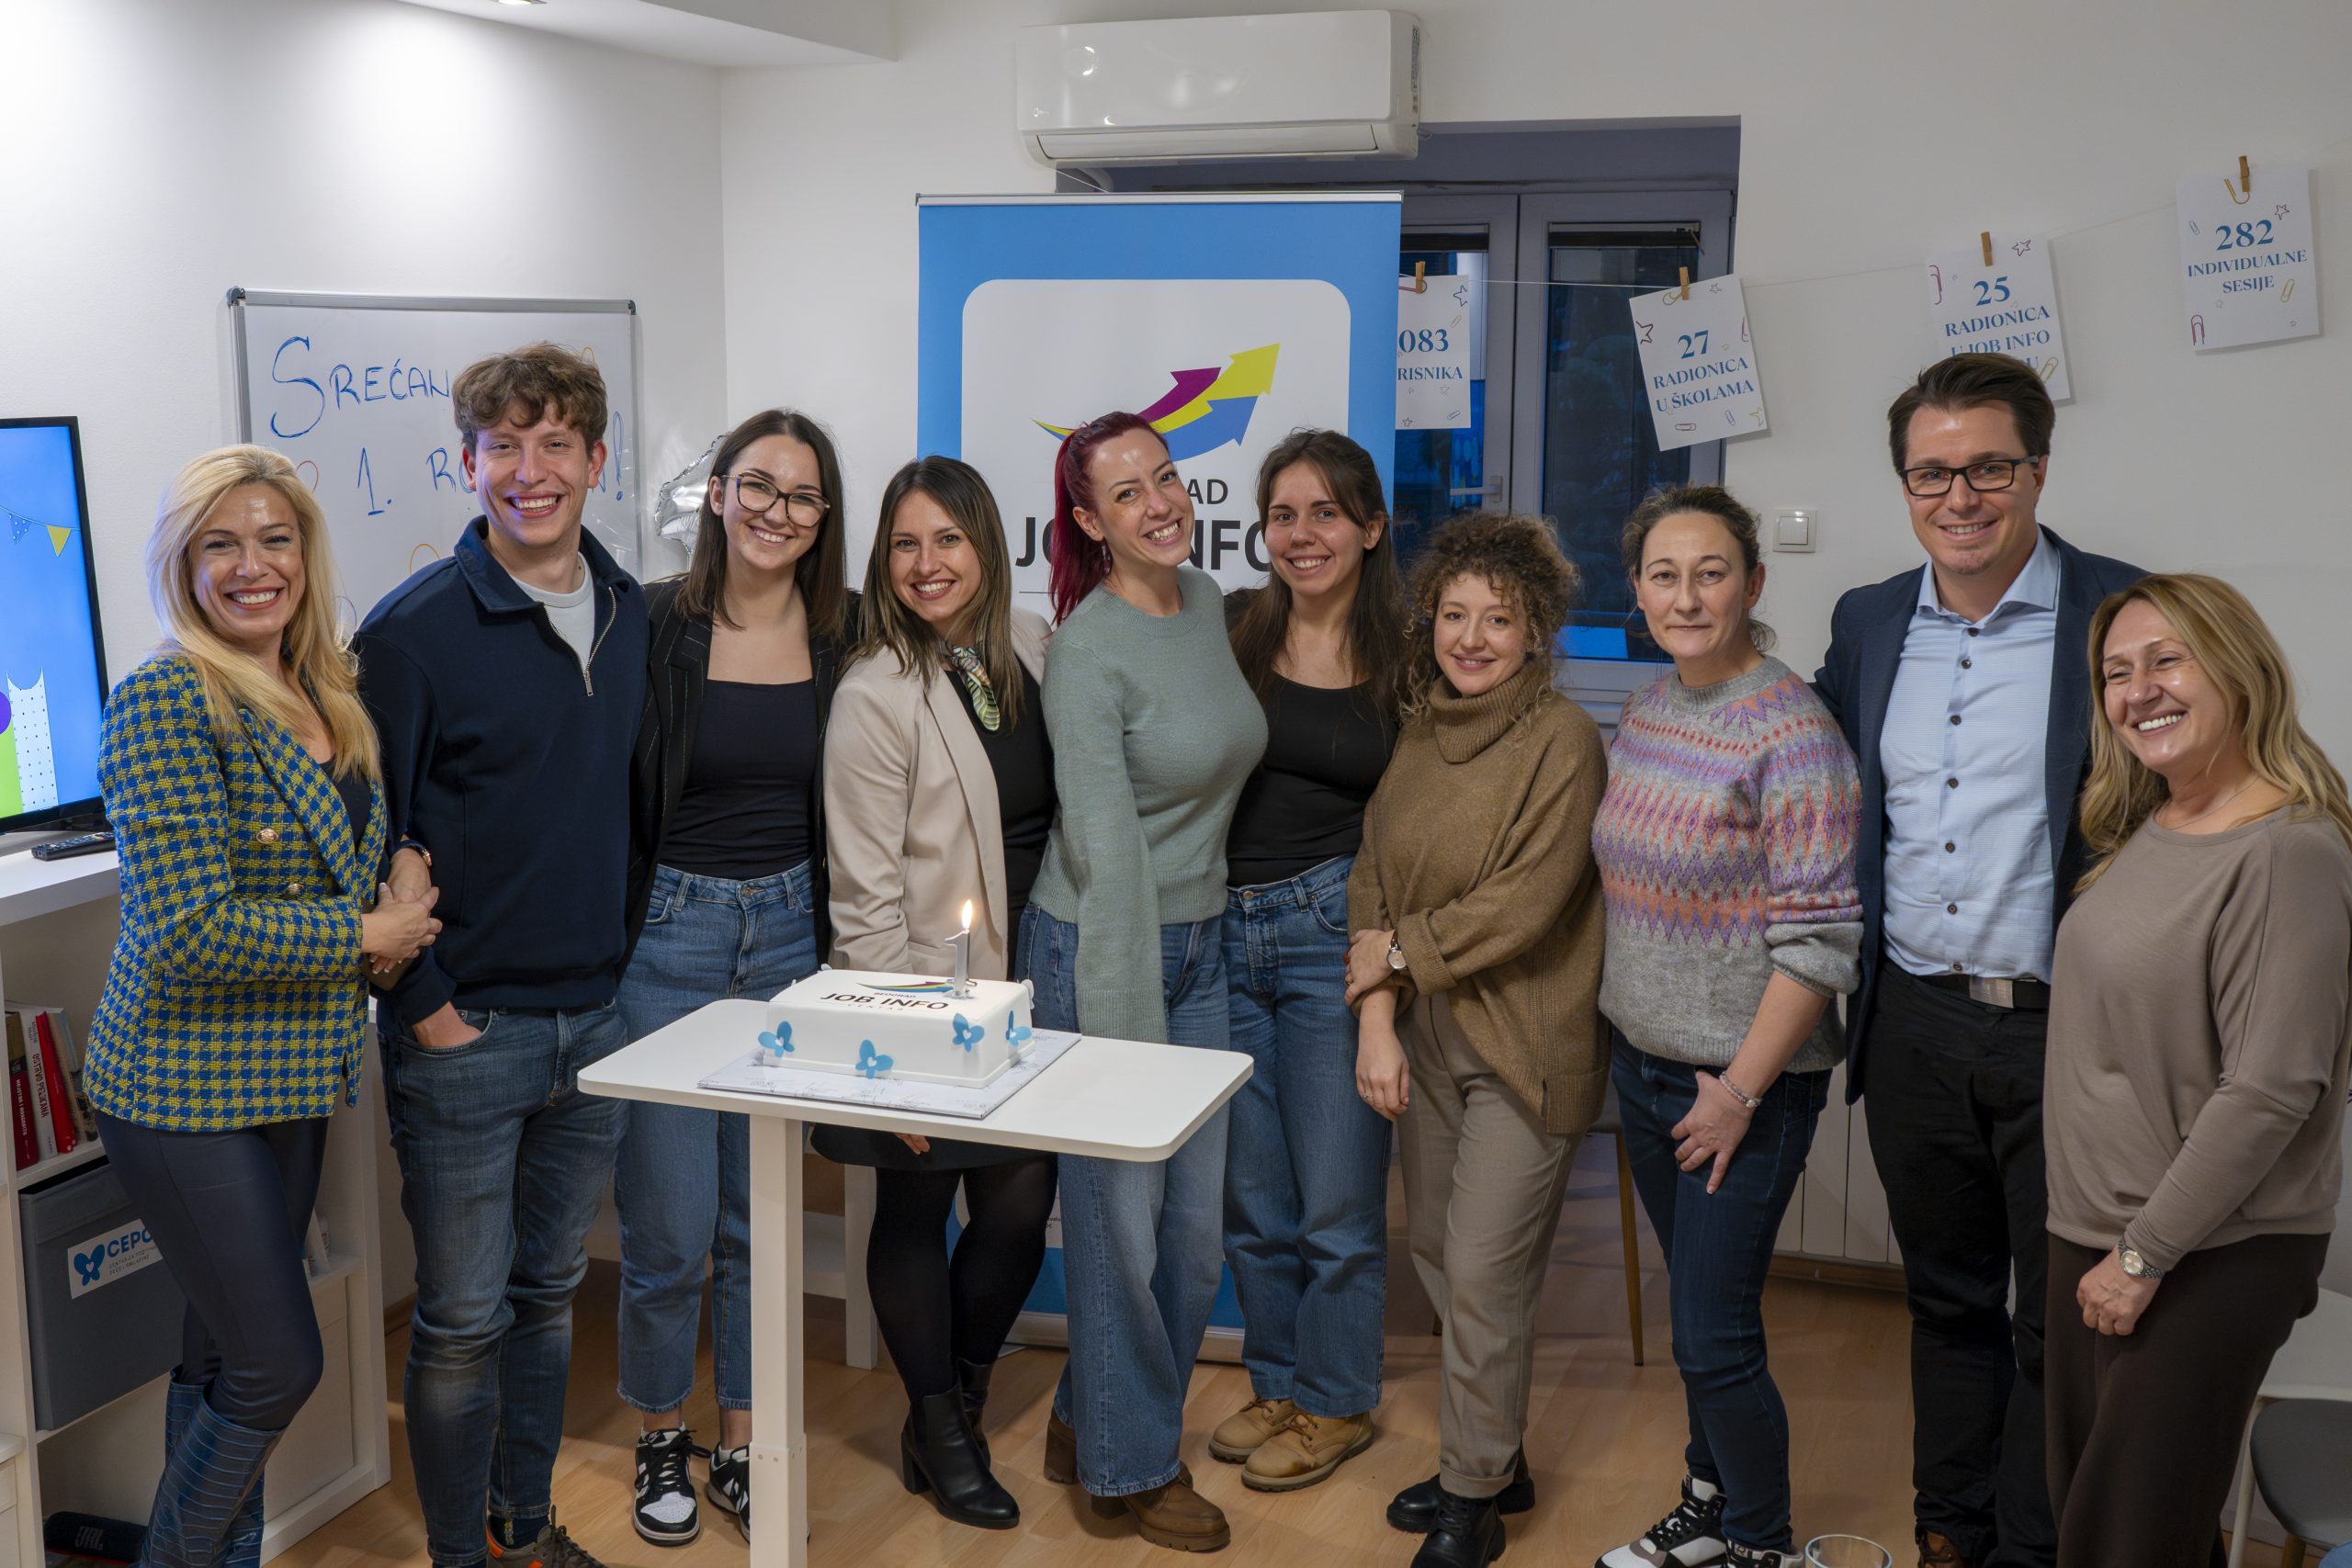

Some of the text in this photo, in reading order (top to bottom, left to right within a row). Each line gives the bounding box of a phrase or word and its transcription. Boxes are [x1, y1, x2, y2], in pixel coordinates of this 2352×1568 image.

[2215, 219, 2274, 251] 282
[2188, 249, 2308, 277] INDIVIDUALNE
[1973, 276, 2010, 306] 25
[2222, 275, 2275, 293] SESIJE
[1945, 305, 2050, 337] RADIONICA
[1398, 329, 1449, 354] 083
[1678, 330, 1709, 359] 27
[2006, 330, 2050, 350] INFO
[270, 336, 450, 438] SREĆAN
[1397, 366, 1463, 381] RISNIKA
[1654, 356, 1748, 389] RADIONICA
[1657, 379, 1754, 412] U ŠKOLAMA
[357, 447, 392, 516] 1.
[1015, 516, 1056, 568] J
[820, 993, 949, 1010] JOB INFO
